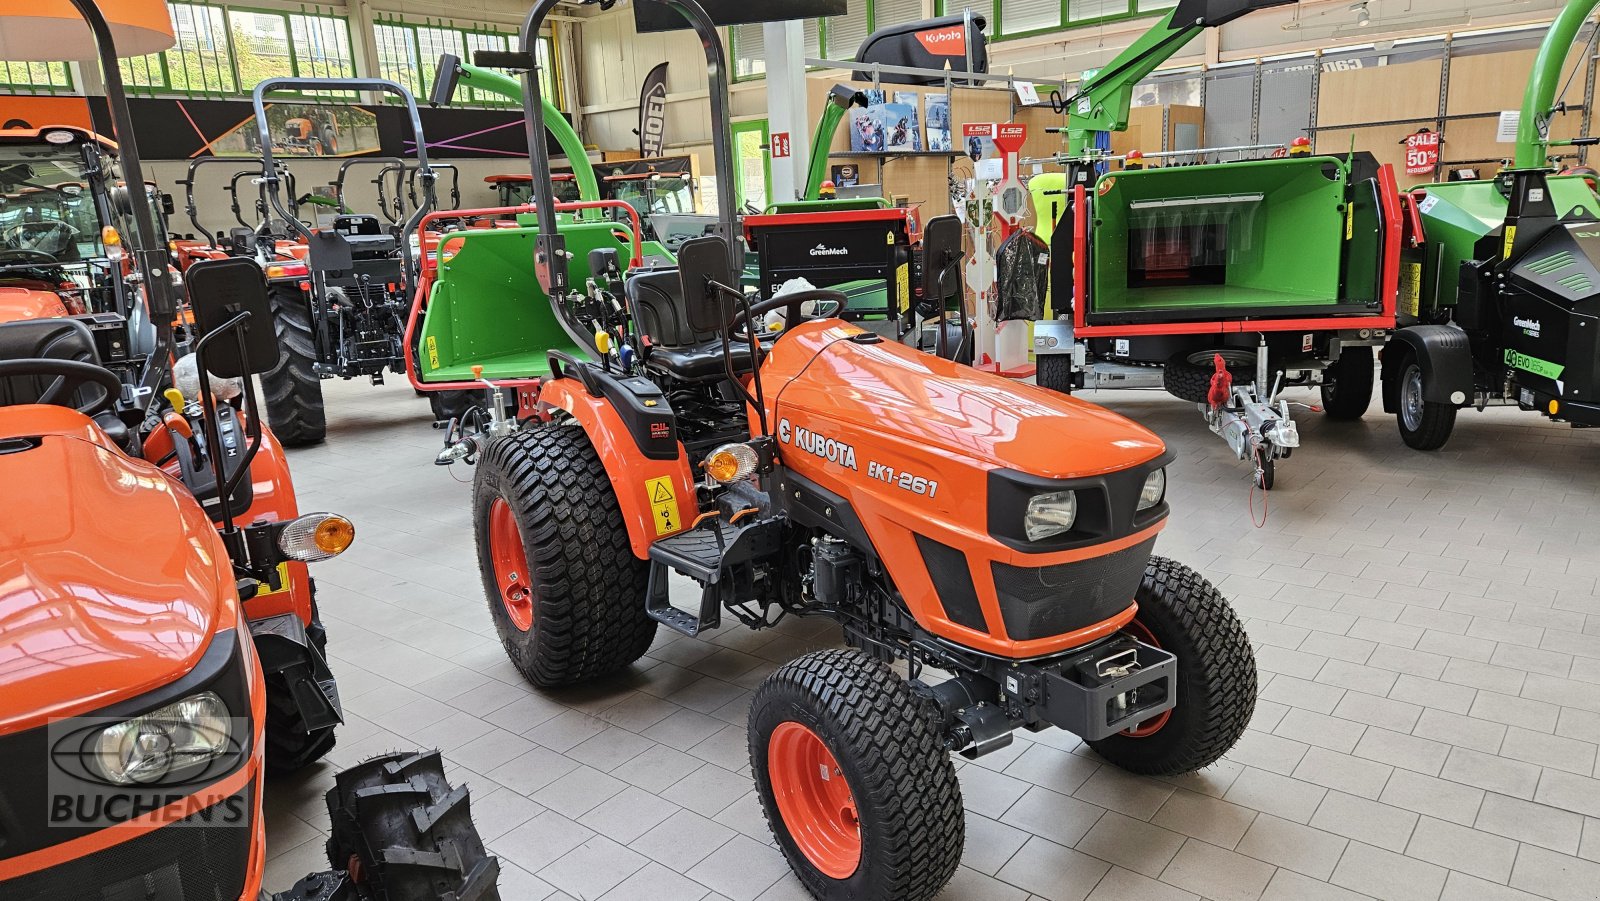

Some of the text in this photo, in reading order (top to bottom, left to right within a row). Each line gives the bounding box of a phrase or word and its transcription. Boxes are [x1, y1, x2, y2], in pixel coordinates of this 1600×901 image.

[925, 31, 961, 43] Kubota
[1408, 134, 1437, 147] SALE
[809, 247, 848, 256] GreenMech
[1513, 316, 1541, 331] GreenMech
[1517, 356, 1530, 369] EVO
[794, 425, 858, 471] KUBOTA
[867, 460, 938, 498] EK1-261
